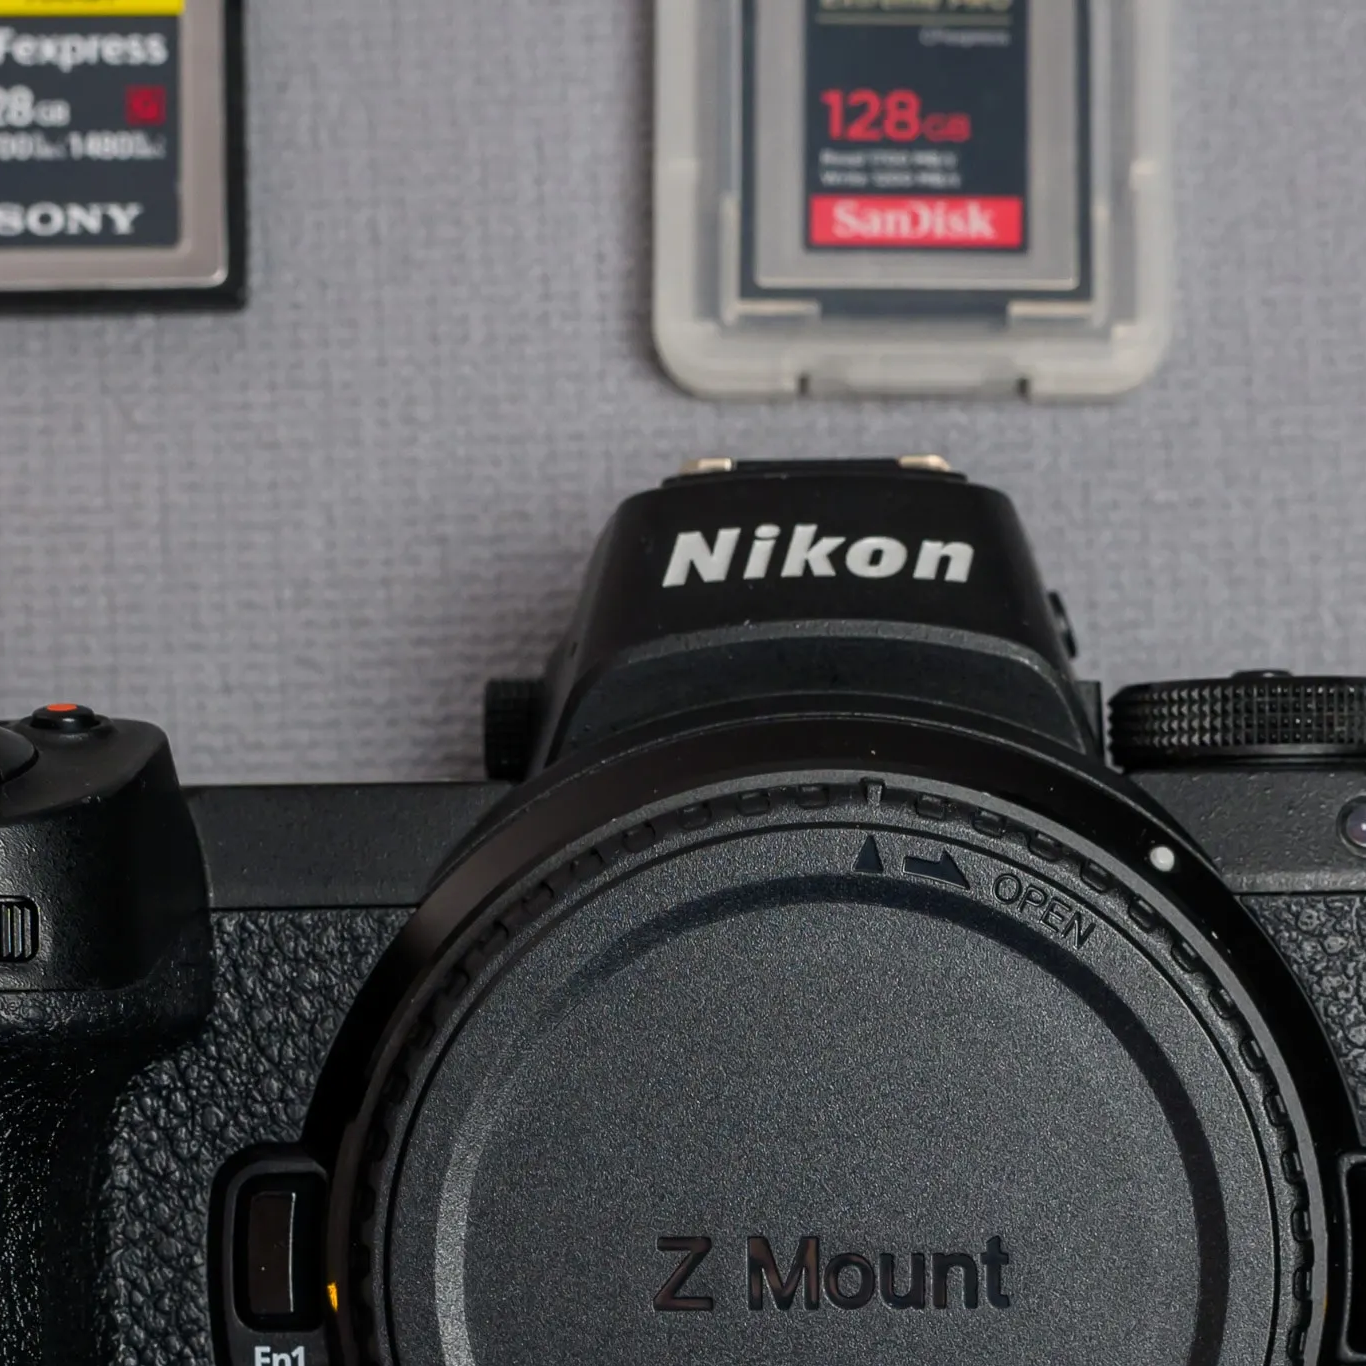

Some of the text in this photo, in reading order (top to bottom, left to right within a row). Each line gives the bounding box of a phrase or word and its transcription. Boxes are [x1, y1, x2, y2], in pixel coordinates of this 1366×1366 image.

[820, 89, 971, 142] 128GB
[833, 200, 996, 240] SanDisk
[662, 524, 974, 587] Nikon
[994, 873, 1096, 949] OPEN
[653, 1235, 1009, 1311] Z Mount
